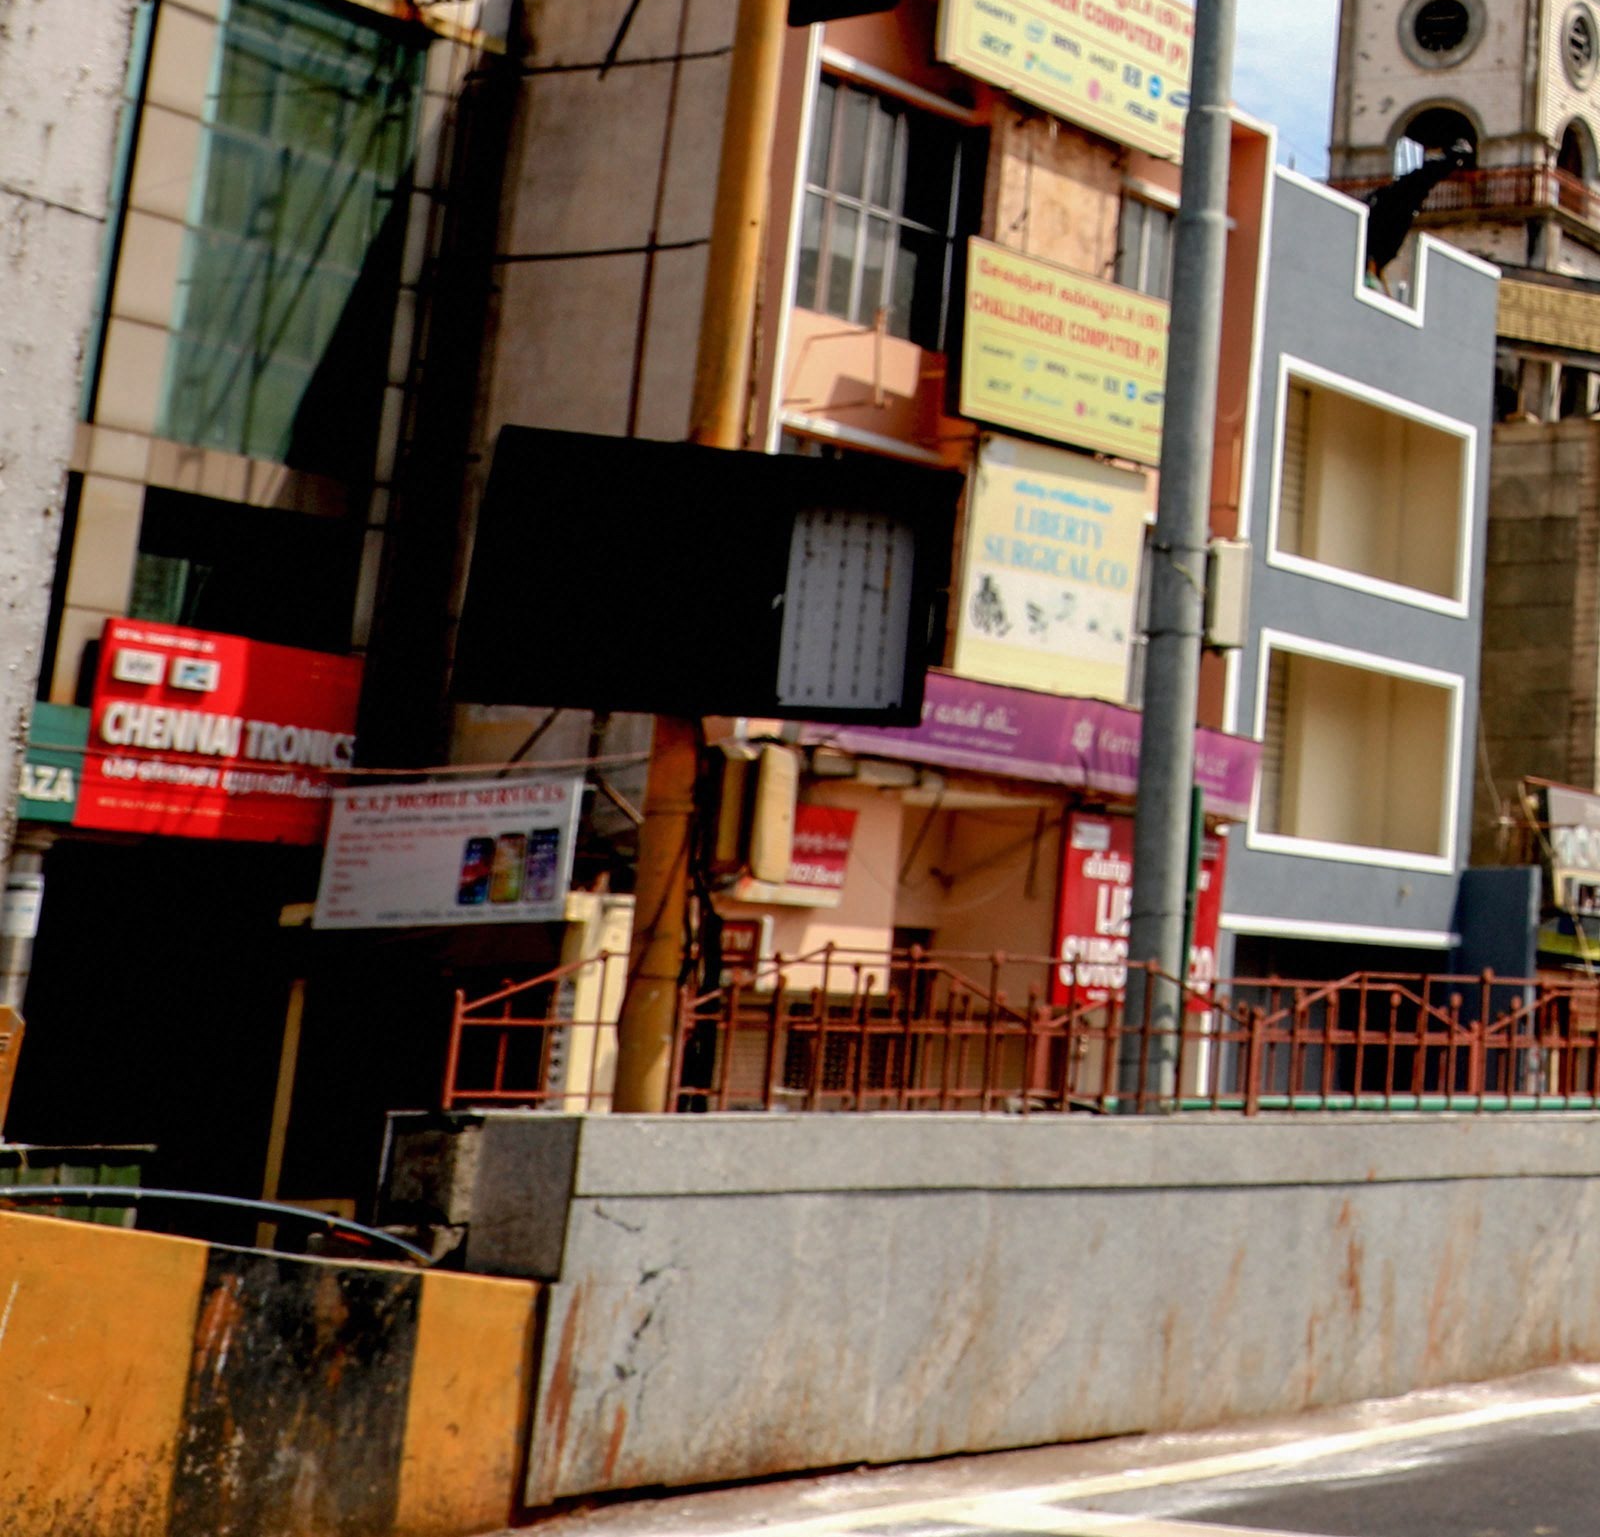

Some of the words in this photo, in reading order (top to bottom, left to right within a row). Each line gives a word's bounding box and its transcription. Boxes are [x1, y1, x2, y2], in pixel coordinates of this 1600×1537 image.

[1082, 0, 1166, 56] COMPUTER
[969, 291, 1065, 338] CHALLENGER
[1068, 322, 1143, 360] COMPUTER
[1013, 502, 1107, 551] LIBERTY
[101, 700, 244, 759] CHENNAI
[243, 718, 357, 770] TRONICS
